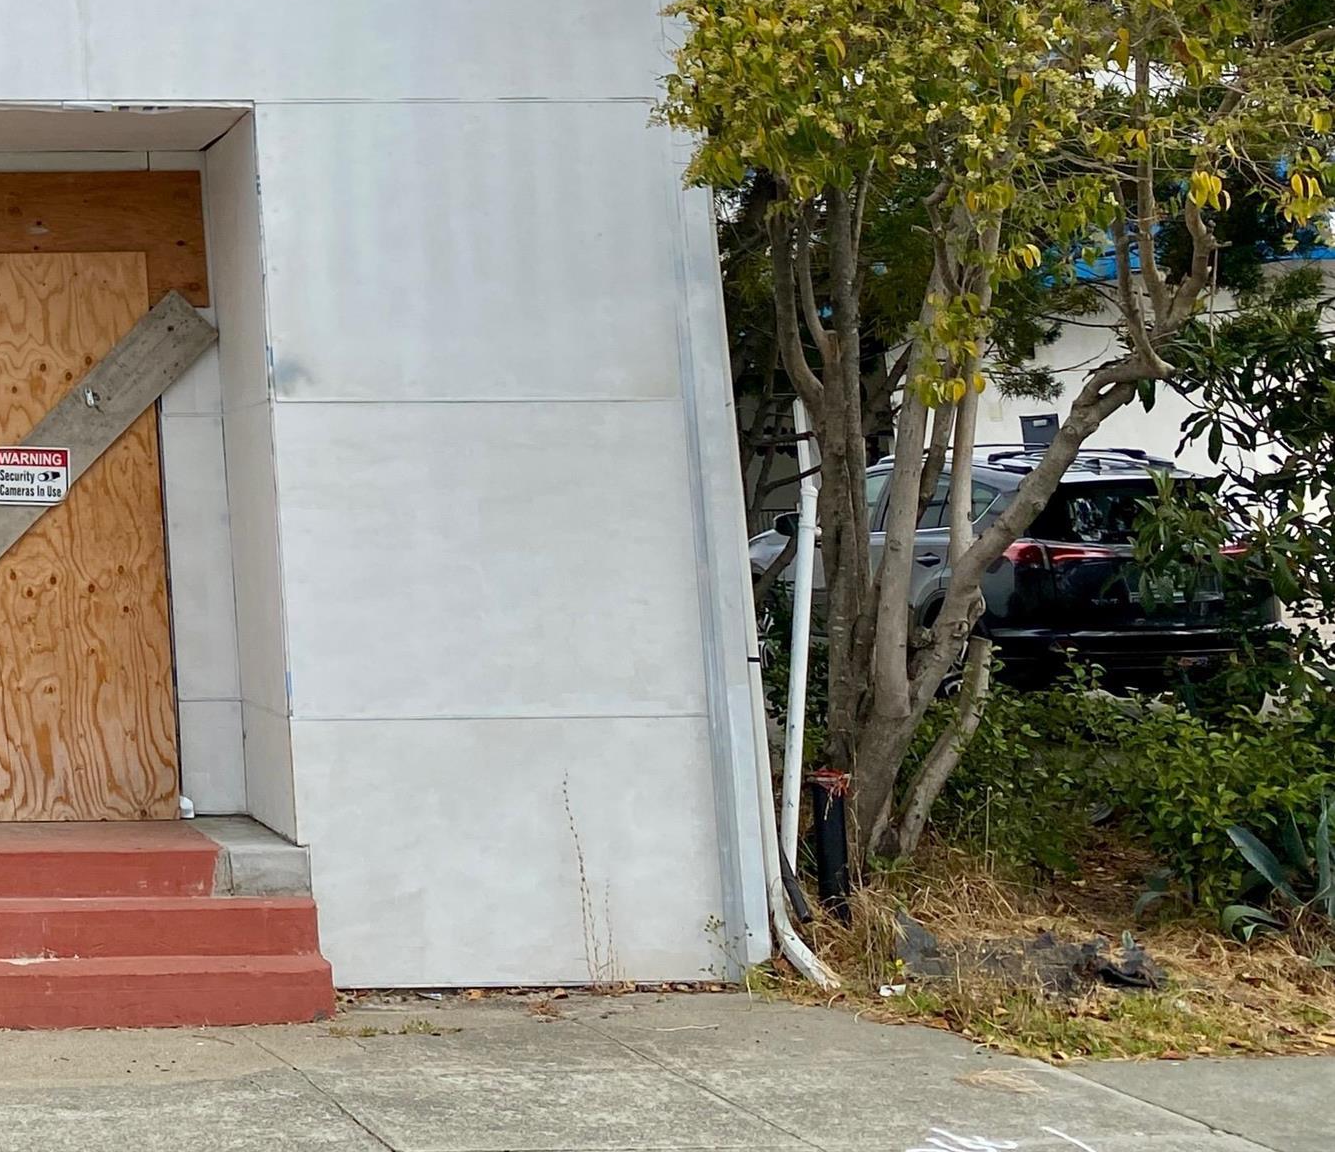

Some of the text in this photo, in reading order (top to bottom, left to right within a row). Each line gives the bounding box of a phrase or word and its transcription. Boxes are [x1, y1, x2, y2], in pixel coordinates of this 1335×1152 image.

[0, 469, 35, 484] Security
[0, 484, 62, 498] Cameras In Use
